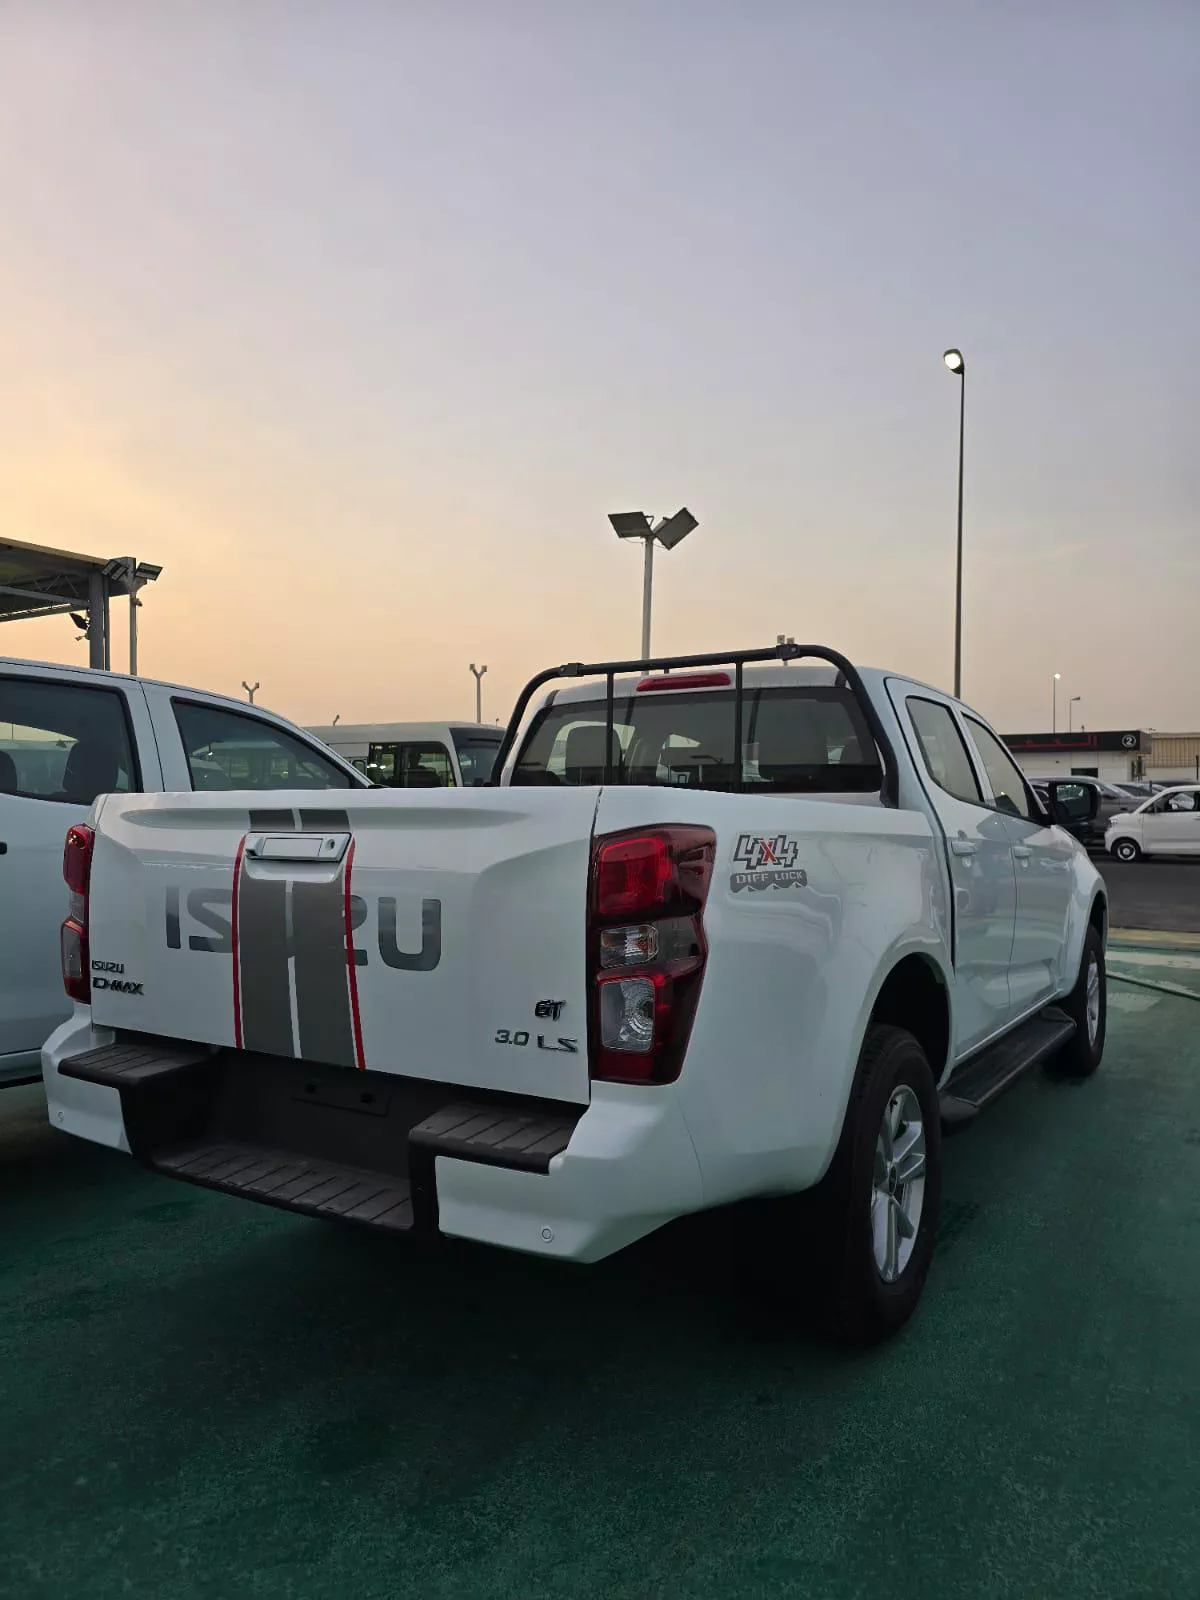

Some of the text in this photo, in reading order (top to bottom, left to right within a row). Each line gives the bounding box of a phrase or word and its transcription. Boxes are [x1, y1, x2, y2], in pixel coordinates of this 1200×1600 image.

[736, 871, 803, 883] DIFF LOCK
[165, 885, 442, 972] ISU
[91, 960, 125, 974] ISUZU
[92, 976, 145, 996] D-MAX
[535, 999, 566, 1021] GT
[495, 1029, 578, 1053] 3.0 LS
